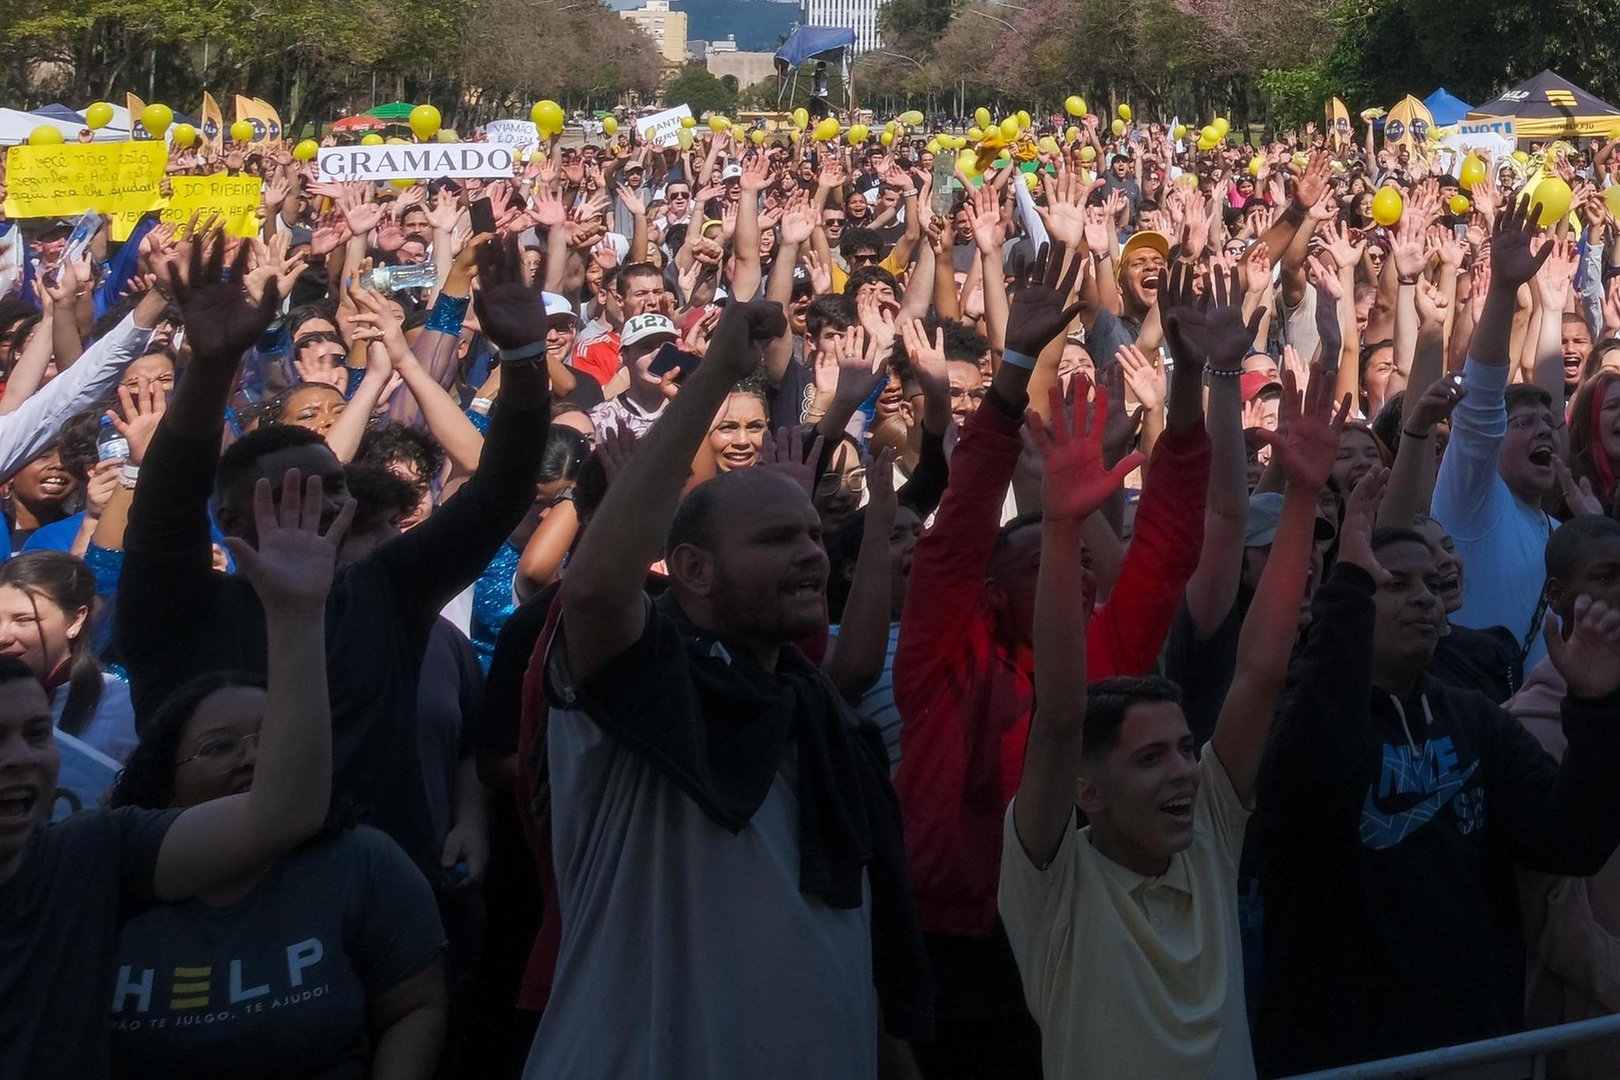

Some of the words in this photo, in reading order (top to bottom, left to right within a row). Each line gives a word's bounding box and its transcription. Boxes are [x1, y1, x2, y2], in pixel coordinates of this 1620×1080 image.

[493, 123, 533, 134] VIAMÃO
[656, 116, 682, 130] ANTA
[320, 148, 513, 175] GRAMADO
[210, 182, 260, 197] RIBEIRO
[630, 315, 667, 333] L27
[111, 937, 324, 1013] HELP
[175, 1011, 237, 1027] JULGO,
[245, 1003, 264, 1015] TE
[271, 984, 330, 1009] AJUDO!
